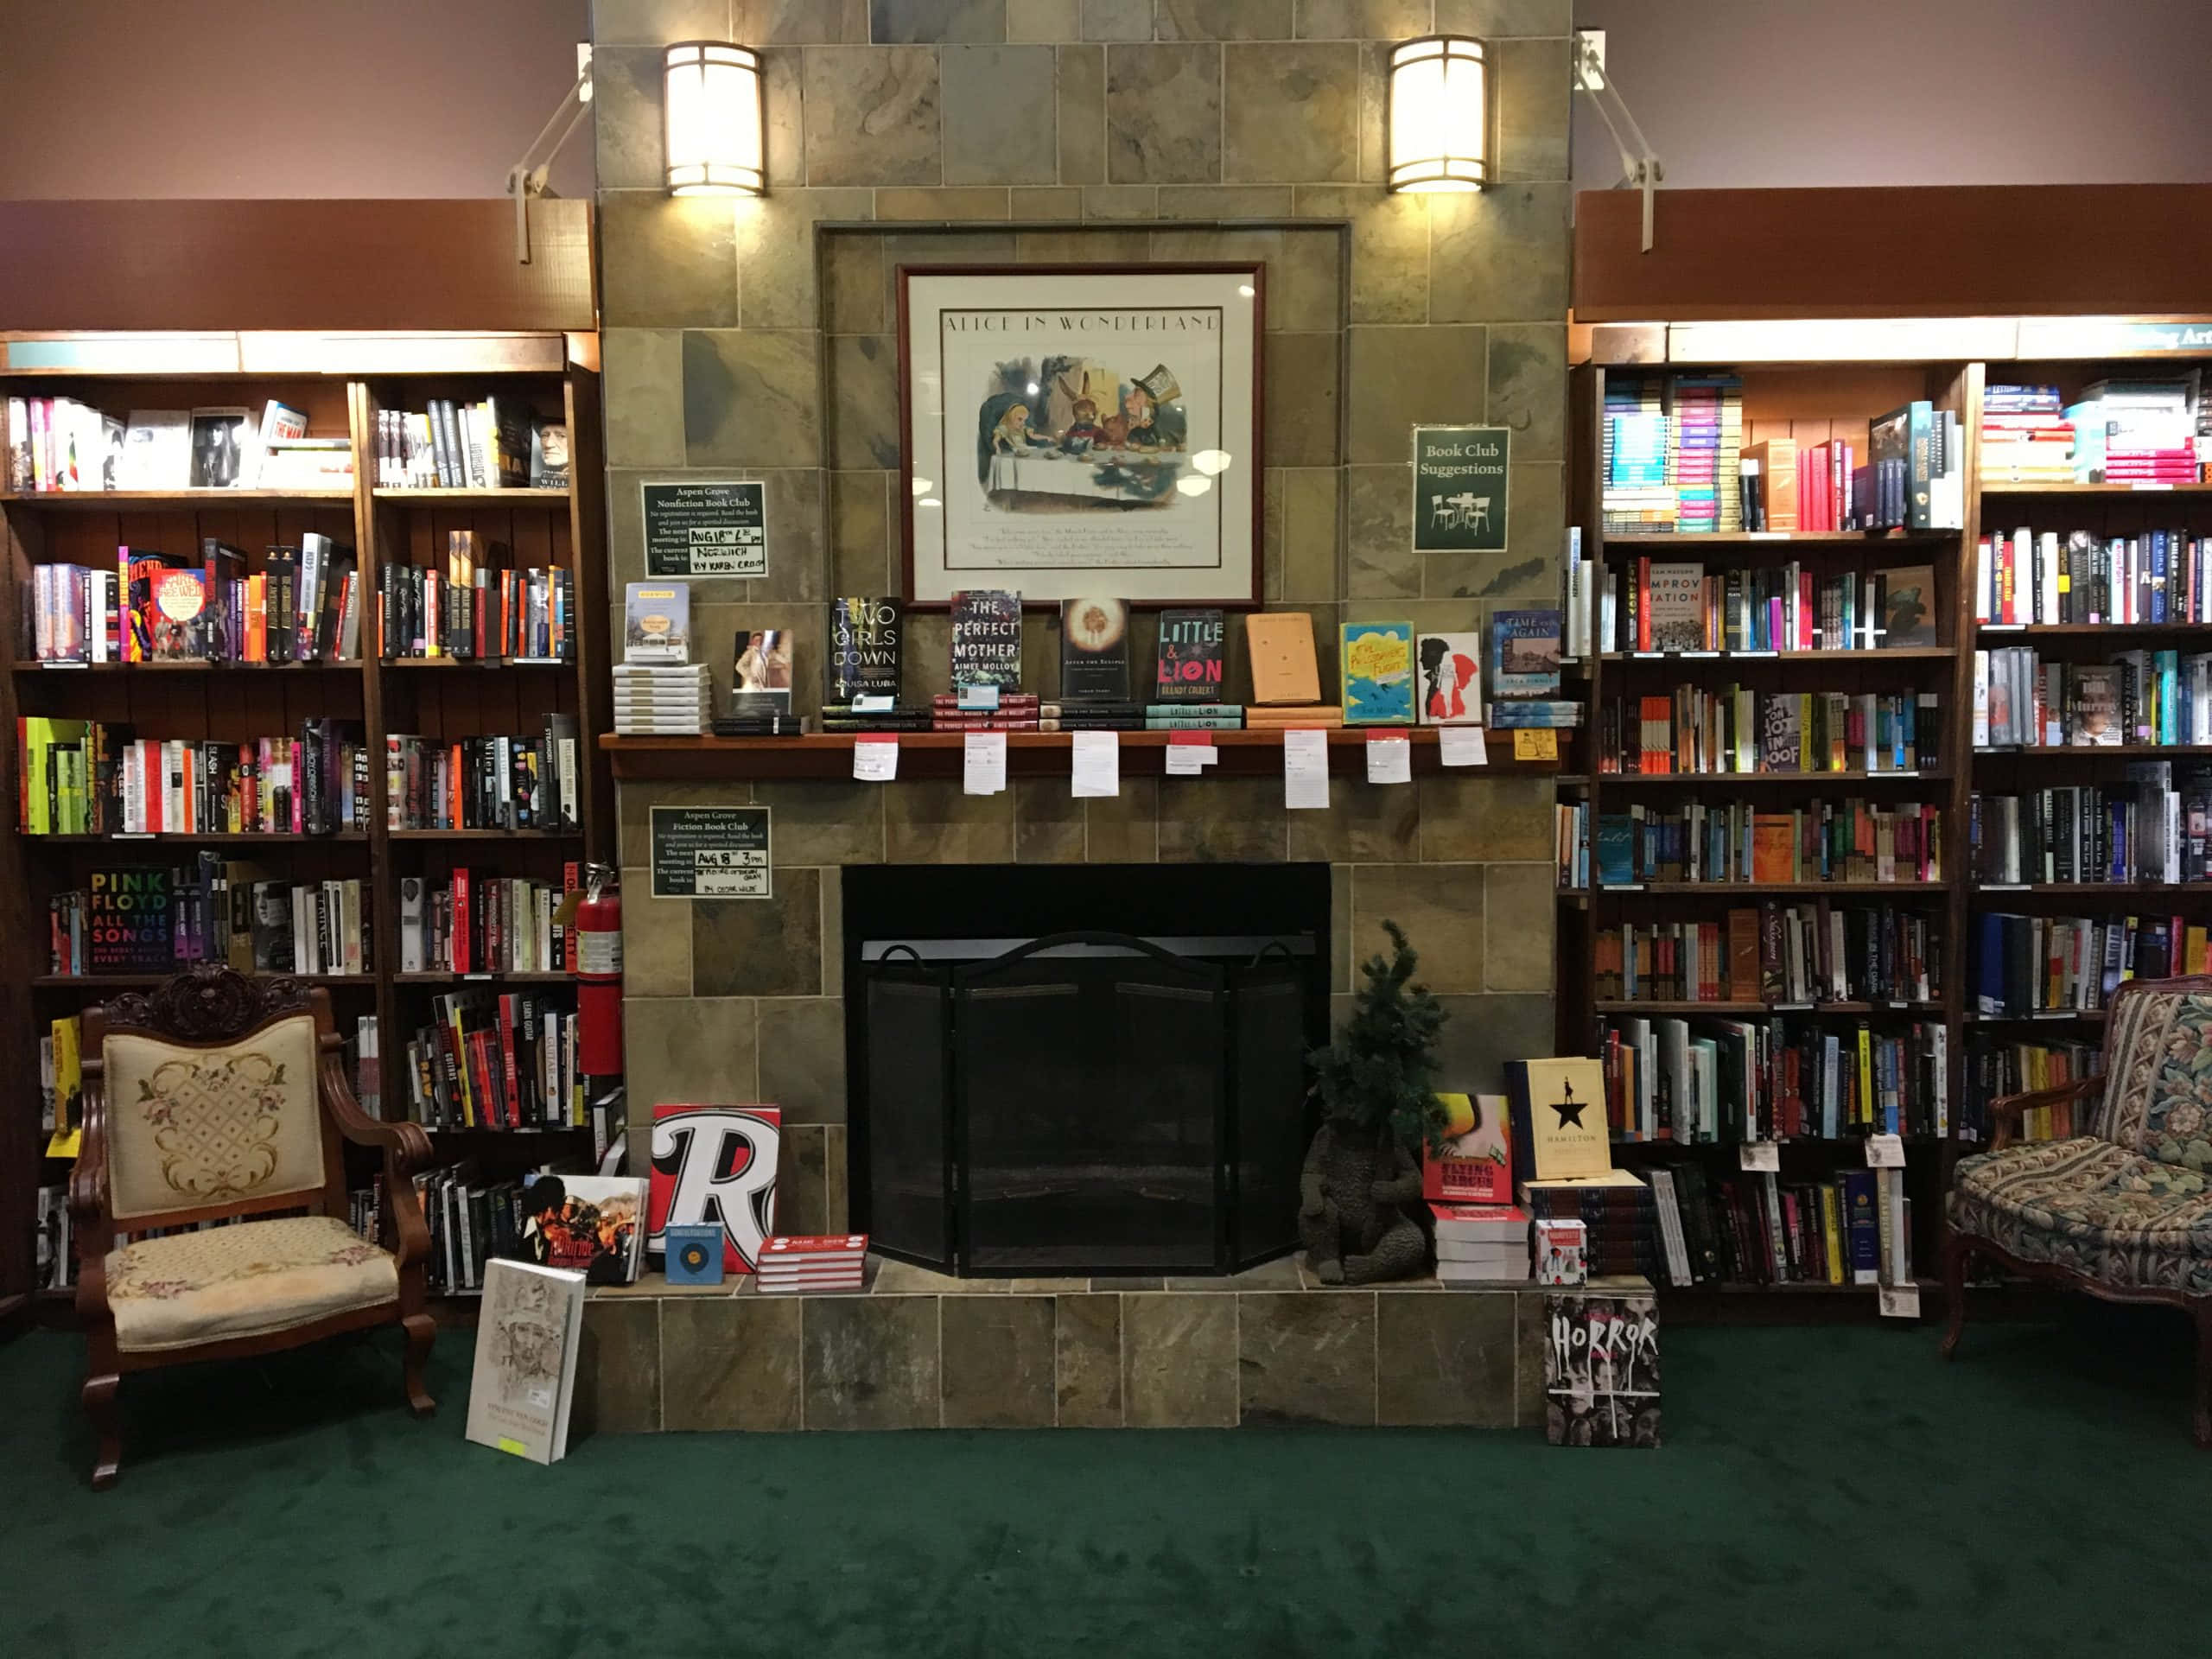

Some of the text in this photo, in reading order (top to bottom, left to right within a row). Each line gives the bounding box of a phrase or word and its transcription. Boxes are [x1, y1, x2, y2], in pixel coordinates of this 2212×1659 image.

[945, 314, 1220, 332] ALICE IN WONDERLAND
[1427, 443, 1499, 457] Book Club
[1421, 463, 1503, 478] Suggestions
[677, 488, 703, 497] Aspen
[657, 498, 751, 508] Nonfiction Book Club
[691, 531, 713, 543] AUG
[2157, 535, 2164, 546] MY
[305, 551, 315, 570] KISS
[130, 560, 162, 582] HEND
[1651, 579, 1700, 588] MPROV
[346, 594, 354, 618] JONES
[462, 589, 471, 629] WILLIE NELSON
[972, 601, 997, 614] THE
[836, 605, 895, 626] TWO
[1506, 617, 1538, 627] TIME
[954, 622, 1016, 637] PERFECT
[1160, 621, 1224, 643] LITTLE
[1510, 627, 1549, 638] AGAIN
[835, 630, 896, 646] GIRLS
[834, 650, 896, 666] DOWN
[954, 644, 1016, 658] MOTHER
[1166, 644, 1177, 658] &
[954, 663, 1015, 671] AIMEE MOLLOY
[1158, 659, 1223, 683] LION
[1374, 661, 1401, 676] FLIGHT
[544, 728, 553, 764] STRAYHORN
[208, 746, 218, 774] SLASH
[485, 741, 495, 772] Miles
[564, 741, 573, 777] THELONIOUS
[684, 811, 736, 821] Aspen Grove
[728, 822, 748, 830] Club
[698, 852, 718, 866] Aug
[91, 873, 166, 893] PINK
[92, 893, 168, 911] FLOYD
[92, 914, 167, 927] ALL THE
[92, 929, 168, 944] SONGS
[566, 927, 575, 955] ETTY
[523, 1001, 534, 1040] LEARN GUITAR
[545, 1036, 556, 1074] GUITAR
[444, 1052, 457, 1081] GUITARS
[505, 1052, 516, 1080] GUITARS
[420, 1061, 433, 1096] RAW
[1548, 1135, 1597, 1143] HAMILTON
[1441, 1164, 1493, 1176] FLYING
[1441, 1176, 1493, 1188] CIRCUS
[1552, 1315, 1658, 1367] HORROR
